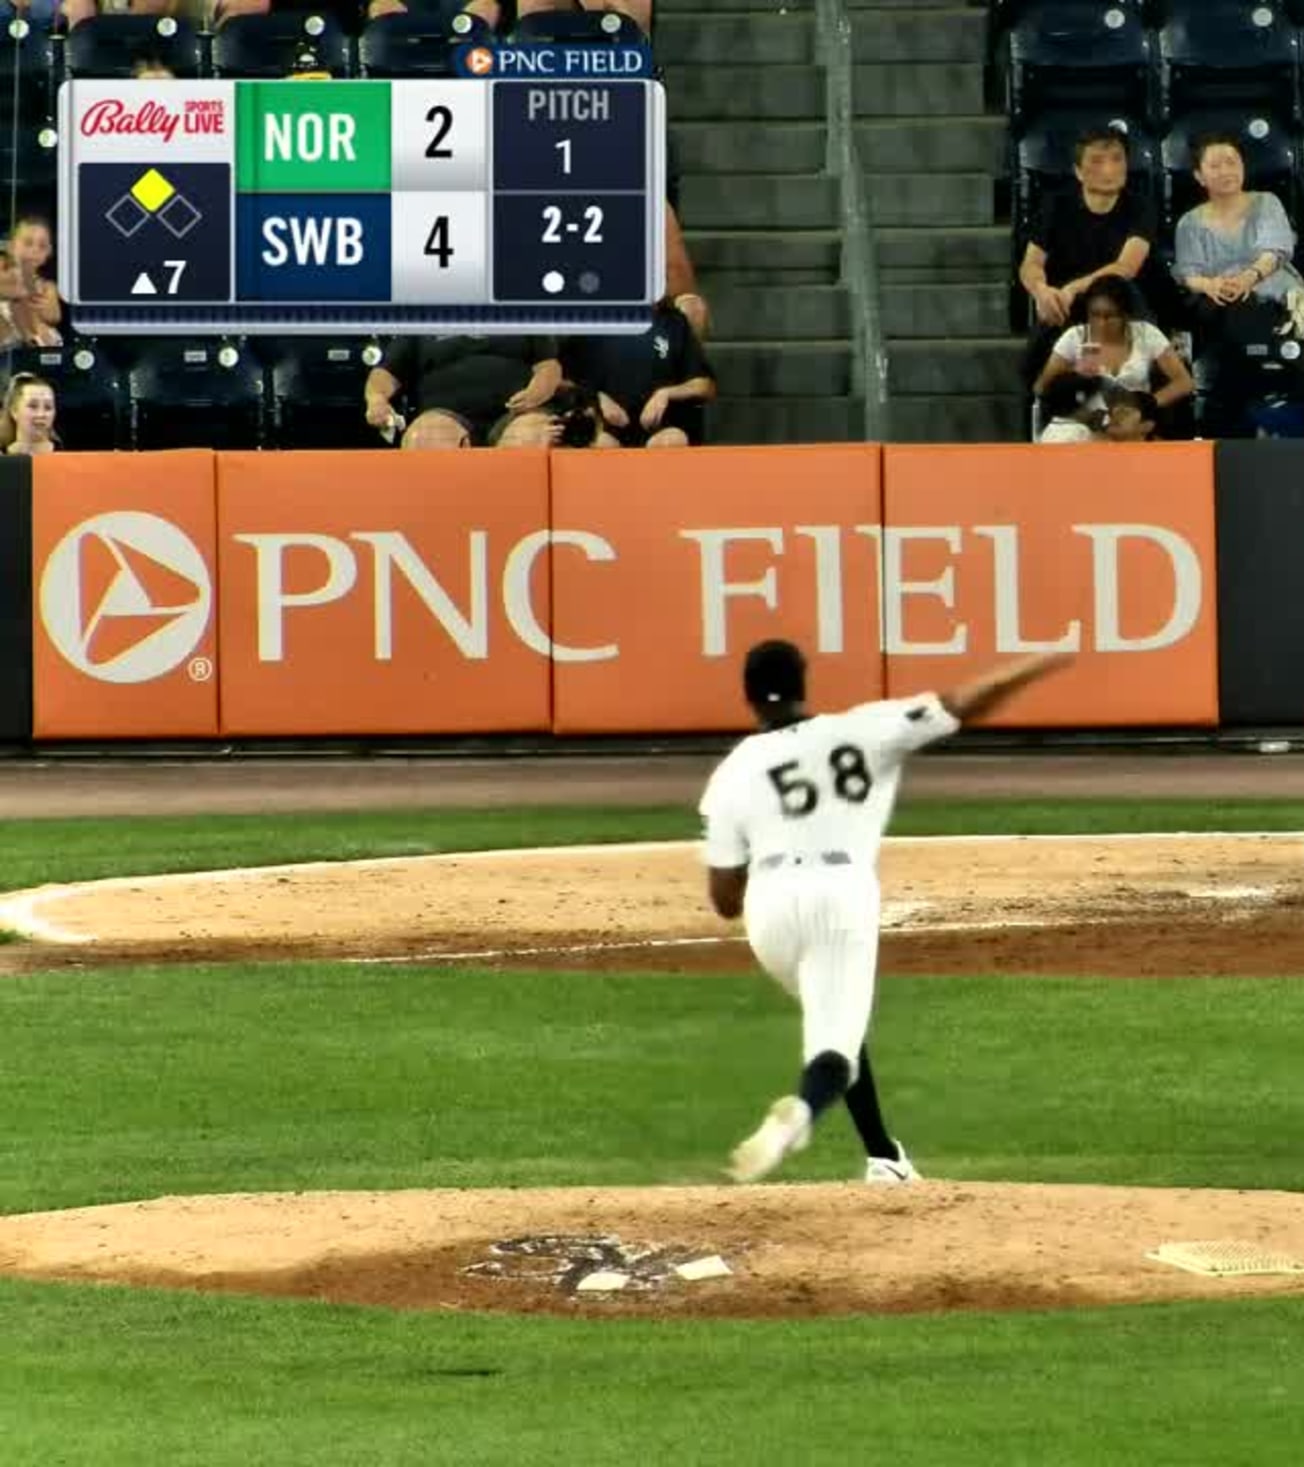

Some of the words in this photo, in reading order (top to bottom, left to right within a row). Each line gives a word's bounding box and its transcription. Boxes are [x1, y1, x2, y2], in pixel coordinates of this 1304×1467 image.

[234, 528, 619, 662] PNC
[679, 523, 1203, 656] FIELD
[766, 743, 874, 819] 58
